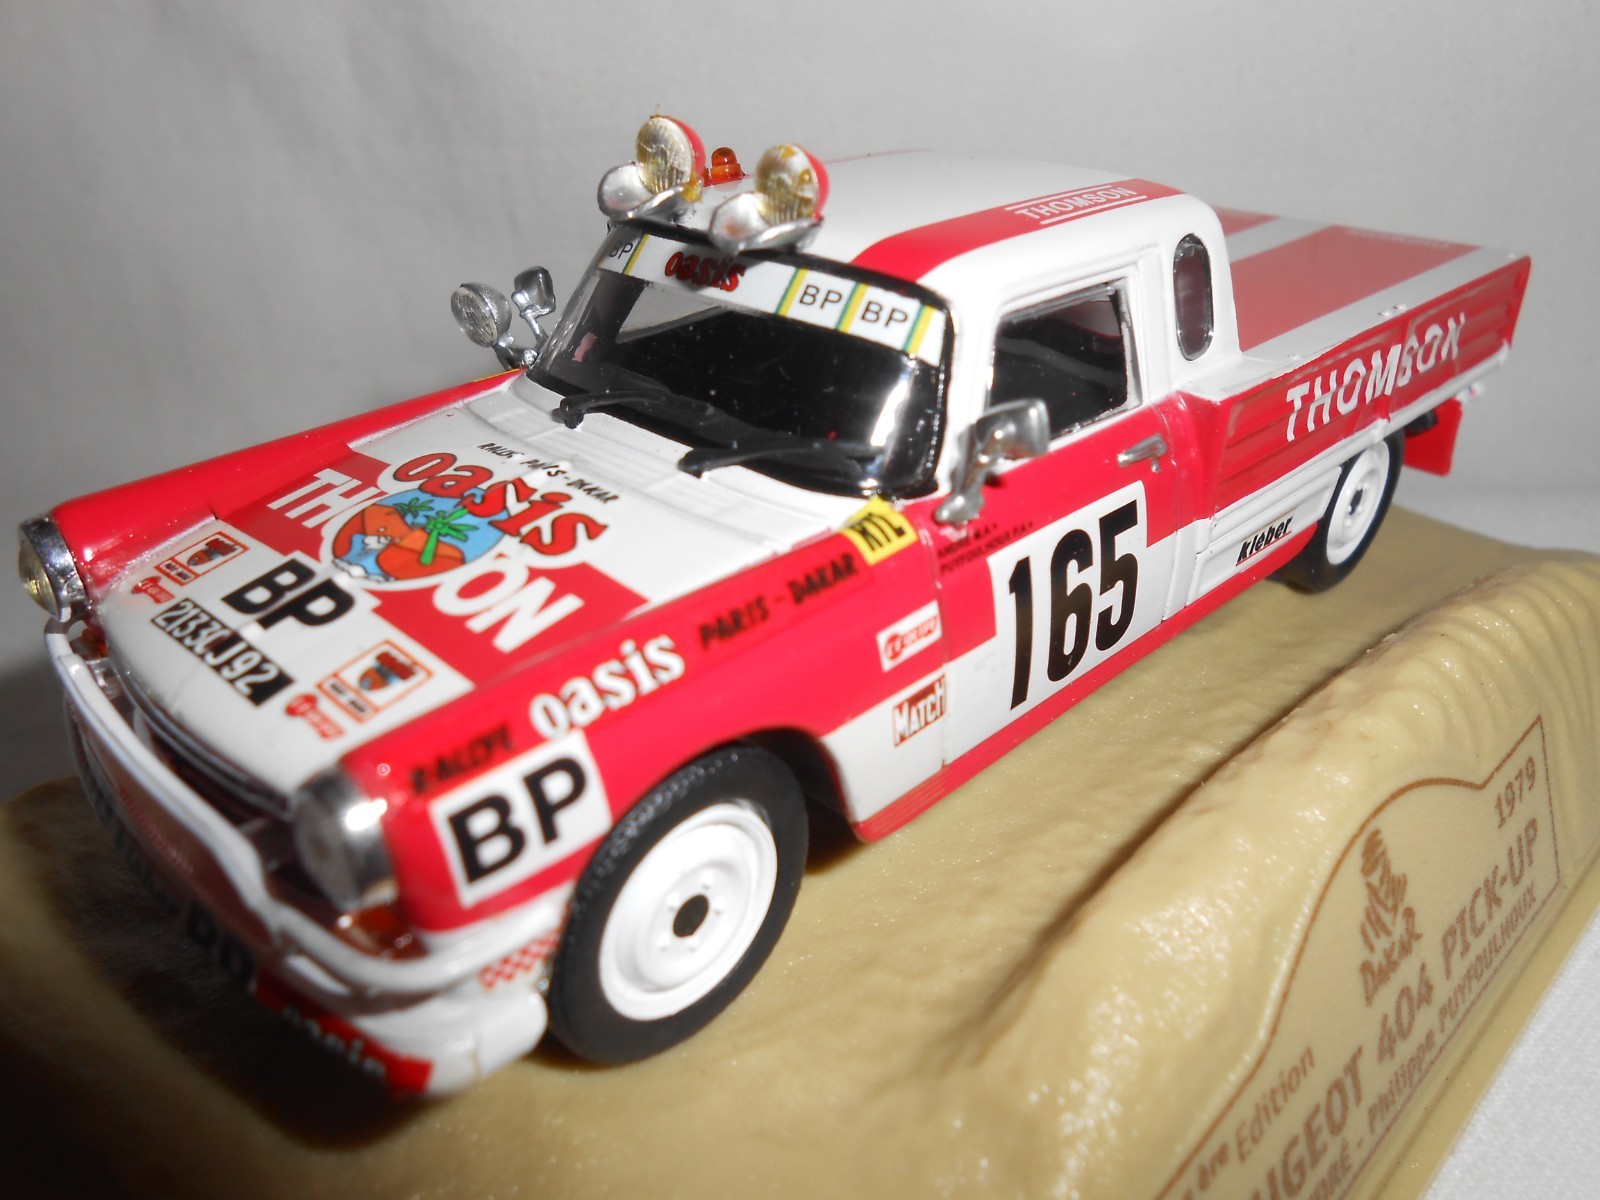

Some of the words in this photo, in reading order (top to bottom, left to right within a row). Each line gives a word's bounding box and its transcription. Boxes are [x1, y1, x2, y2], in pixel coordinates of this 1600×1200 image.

[1014, 187, 1137, 219] THOMSON
[799, 284, 842, 311] BP
[861, 300, 909, 328] BP
[1286, 312, 1465, 442] THOMSON
[392, 452, 609, 556] oasis
[221, 557, 356, 630] BP
[698, 595, 770, 649] PARIS
[786, 552, 859, 605] DAKAR
[1008, 498, 1139, 711] 165
[528, 634, 686, 738] oasis
[447, 756, 586, 885] BP
[1494, 757, 1536, 830] 1979
[1377, 963, 1434, 1064] 404
[1441, 818, 1538, 980] PICK-UP
[1235, 1046, 1315, 1164] Edition
